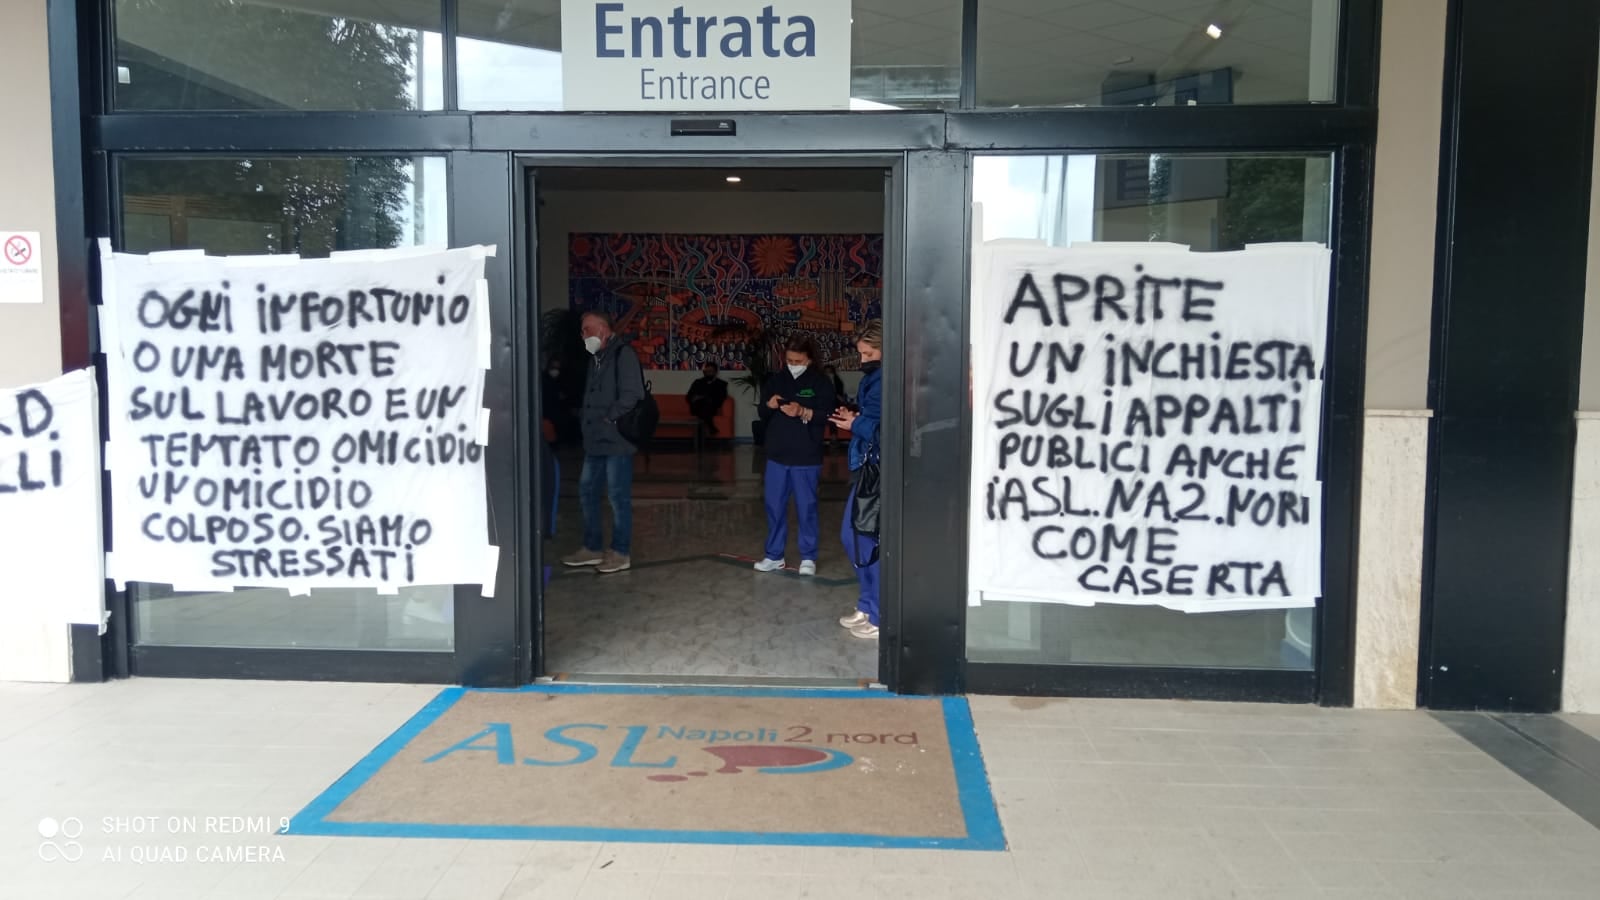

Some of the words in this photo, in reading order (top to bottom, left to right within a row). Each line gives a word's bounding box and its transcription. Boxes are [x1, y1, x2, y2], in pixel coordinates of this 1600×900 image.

[594, 2, 816, 58] Entrata
[640, 68, 770, 100] Entrance
[133, 341, 160, 372] O
[172, 345, 245, 381] UNA
[260, 340, 400, 382] MORTE
[1009, 341, 1085, 385] UN
[129, 386, 205, 420] SUL
[216, 387, 372, 425] LAVORO
[141, 432, 320, 468] TENTATO
[998, 431, 1150, 474] PUBLICI
[1164, 443, 1306, 481] ANCHE
[142, 512, 310, 544] COLPOSO.
[318, 514, 432, 548] SIAMO
[1031, 523, 1179, 566] COME
[1077, 560, 1291, 597] CASERTA
[422, 722, 677, 768] ASL
[656, 724, 778, 744] Napoli
[783, 726, 814, 743] 2
[826, 731, 919, 745] nord
